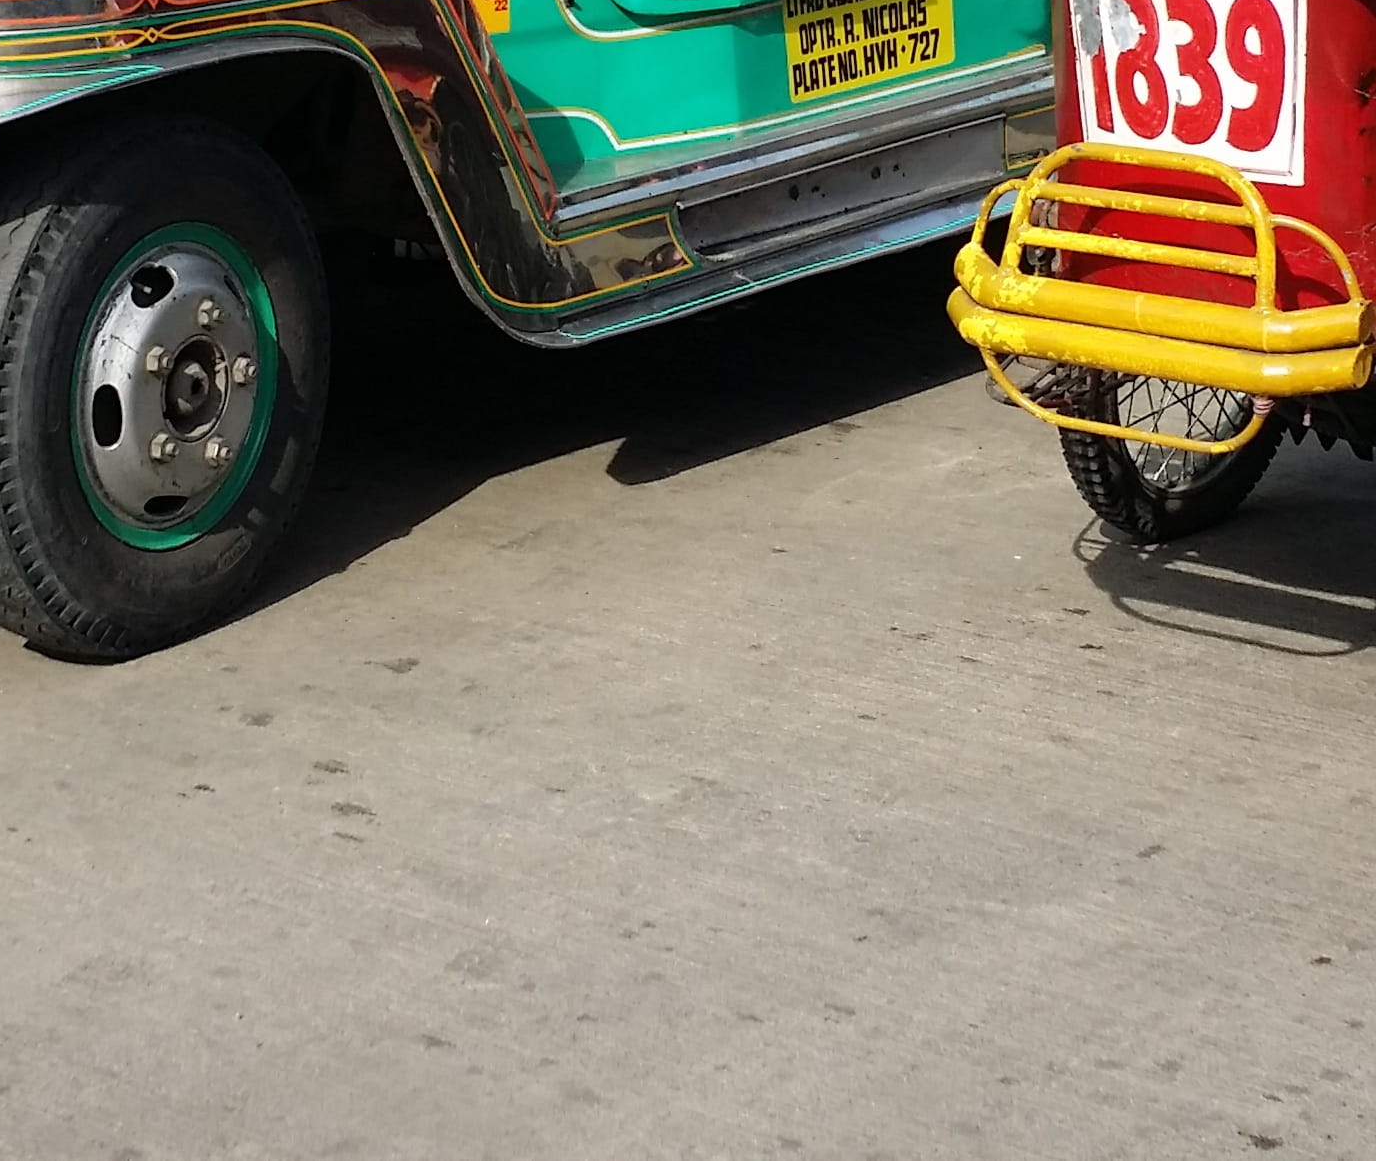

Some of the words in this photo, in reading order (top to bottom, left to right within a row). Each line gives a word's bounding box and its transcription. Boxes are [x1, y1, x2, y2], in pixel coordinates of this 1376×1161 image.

[494, 0, 508, 12] 22
[798, 16, 841, 55] OPTR.
[842, 13, 861, 45] R.
[792, 54, 837, 96] PLATE
